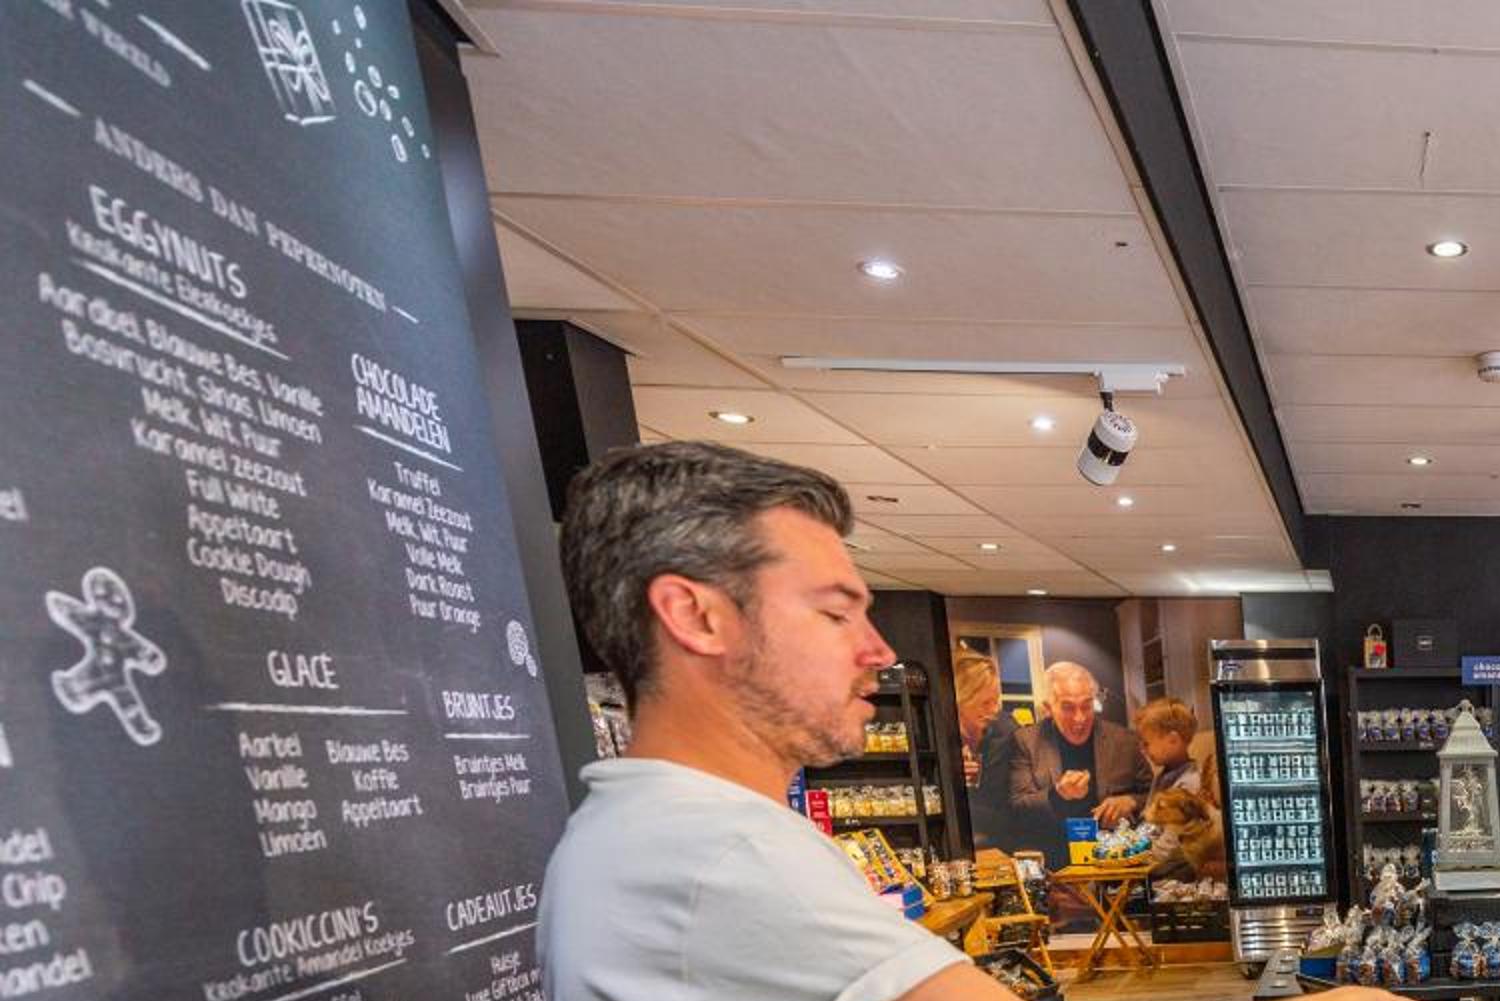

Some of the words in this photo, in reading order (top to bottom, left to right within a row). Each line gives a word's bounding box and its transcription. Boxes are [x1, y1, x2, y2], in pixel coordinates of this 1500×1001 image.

[94, 116, 204, 202] ANDERS
[208, 186, 259, 237] DAN
[264, 220, 386, 314] PEPERNOTEN
[88, 184, 247, 299] EGGYNUTS
[351, 353, 442, 421] CHOCOLADE
[355, 387, 452, 453] AMANDELEN
[130, 417, 229, 472] Karamel
[185, 469, 225, 503] Full
[224, 479, 281, 519] White
[393, 461, 441, 496] Truffel
[187, 503, 297, 554] Appeltaart
[187, 537, 254, 575] Cookie
[254, 551, 312, 595] Dough
[405, 568, 437, 591] Dark
[437, 574, 474, 602] Roast
[439, 598, 481, 634] Orange
[267, 650, 339, 689] GLACE
[325, 739, 381, 764] Blauwe
[381, 739, 410, 763] Bes
[245, 765, 309, 791] Vanille
[352, 769, 399, 792] Koffie
[253, 797, 317, 831] Mango
[341, 794, 423, 828] Appeltaart
[259, 829, 327, 858] Limoen
[3, 871, 66, 910] Chip
[447, 883, 538, 931] CADEAUTJES
[237, 901, 379, 967] COOKICCINI'S
[297, 945, 363, 977] Amandel
